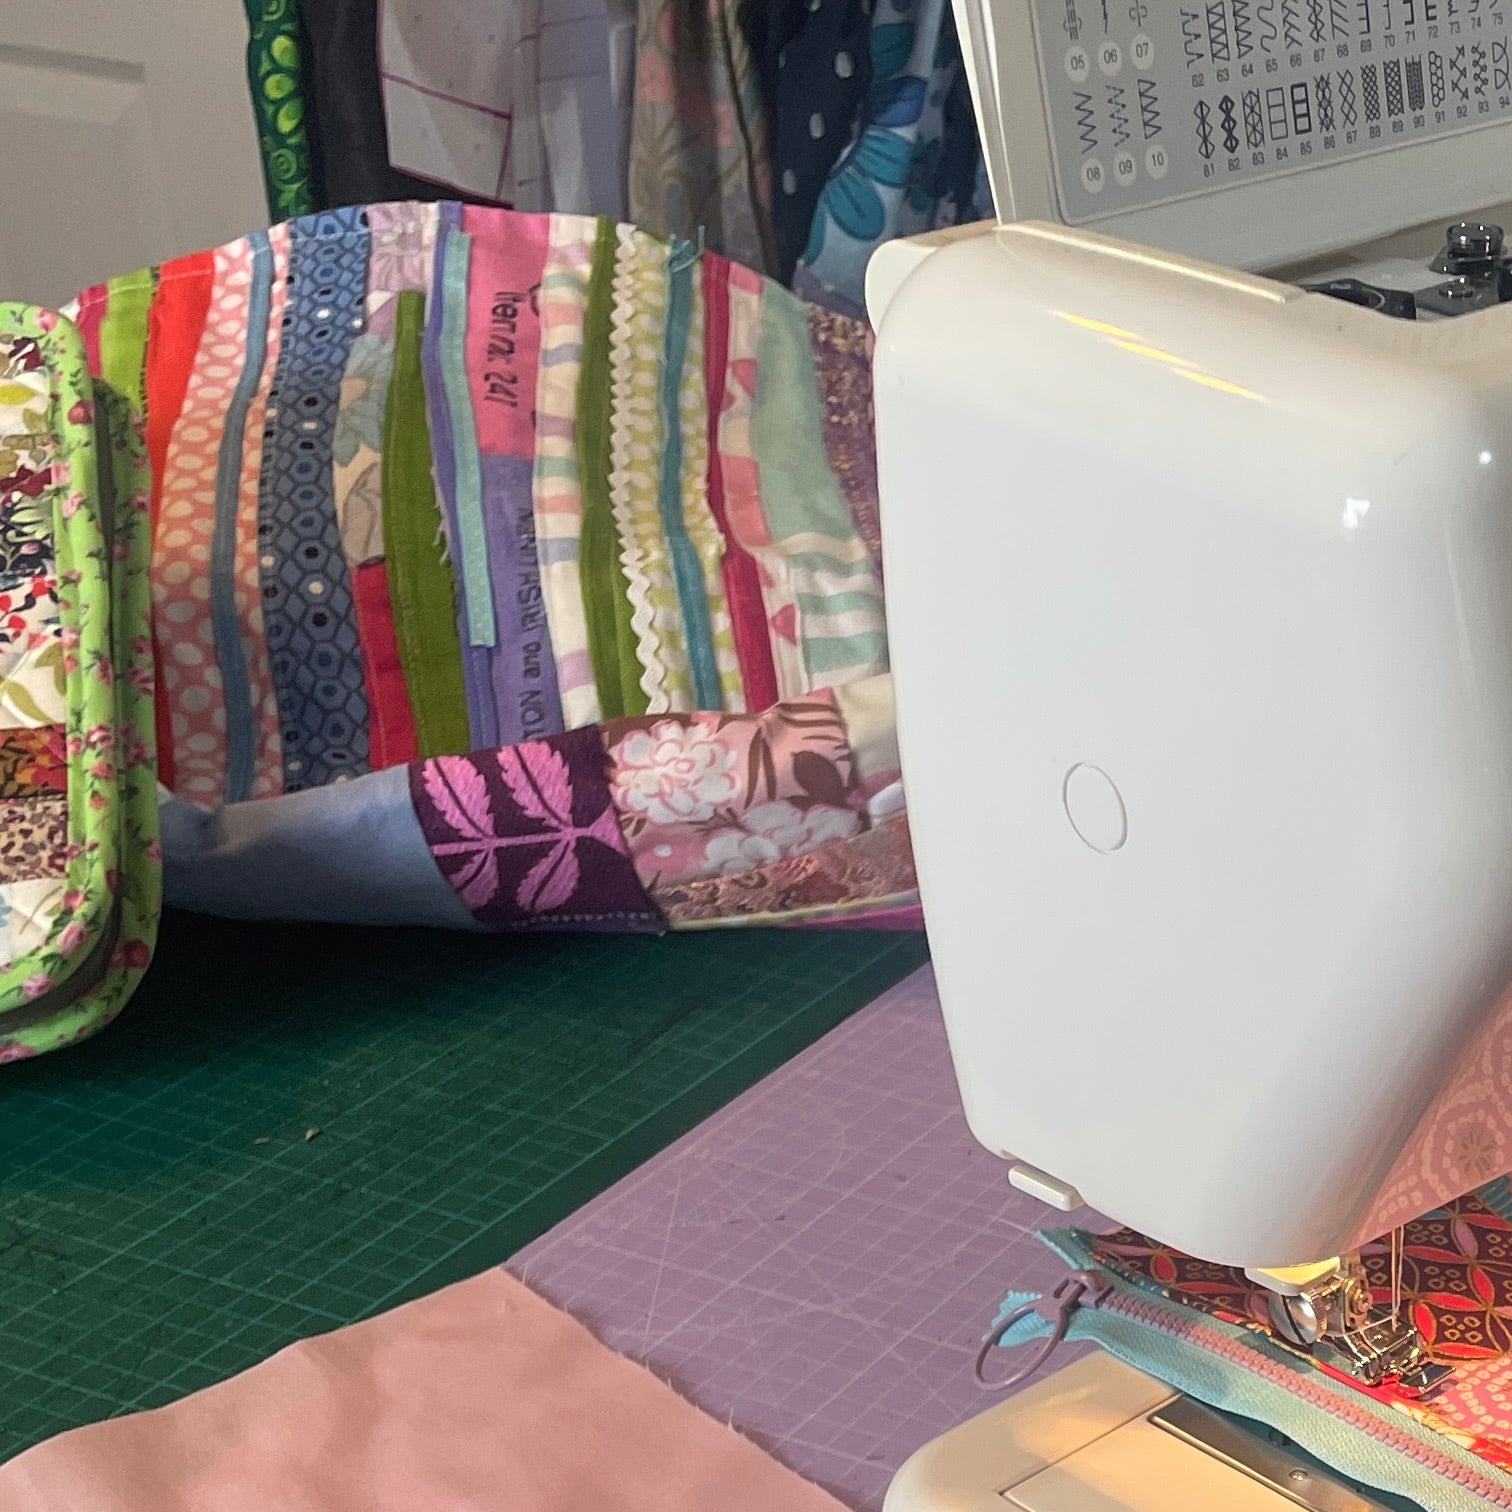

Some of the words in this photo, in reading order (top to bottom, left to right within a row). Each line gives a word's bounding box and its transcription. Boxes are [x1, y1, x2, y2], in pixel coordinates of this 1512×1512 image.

[1070, 57, 1085, 71] 05
[1104, 49, 1118, 63] 06
[1135, 42, 1149, 57] 07
[1191, 74, 1205, 87] 62
[1216, 69, 1230, 82] 63
[1241, 63, 1255, 77] 64
[1265, 58, 1278, 72] 65
[1289, 53, 1302, 67] 66
[1313, 47, 1326, 62] 67
[1337, 43, 1349, 58] 68
[1360, 39, 1372, 53] 69
[1384, 35, 1395, 48] 70
[1406, 31, 1416, 43] 71
[1427, 26, 1438, 38] 72
[1449, 21, 1461, 34] 73
[1471, 17, 1482, 29] 74
[1492, 13, 1503, 25] 75
[1203, 163, 1215, 178] 81
[1228, 158, 1241, 171] 82
[1252, 152, 1265, 166] 83
[1276, 147, 1289, 160] 84
[1300, 141, 1313, 155] 85
[1324, 136, 1336, 149] 86
[1346, 130, 1358, 144] 87
[1369, 125, 1381, 138] 88
[1392, 120, 1404, 133] 89
[1414, 115, 1425, 128] 90
[1435, 110, 1445, 123] 91
[1457, 105, 1468, 118] 92
[1478, 100, 1489, 113] 93
[1499, 95, 1510, 108] 94
[1086, 165, 1101, 181] 08
[1118, 160, 1133, 174] 09
[1152, 152, 1164, 166] 10
